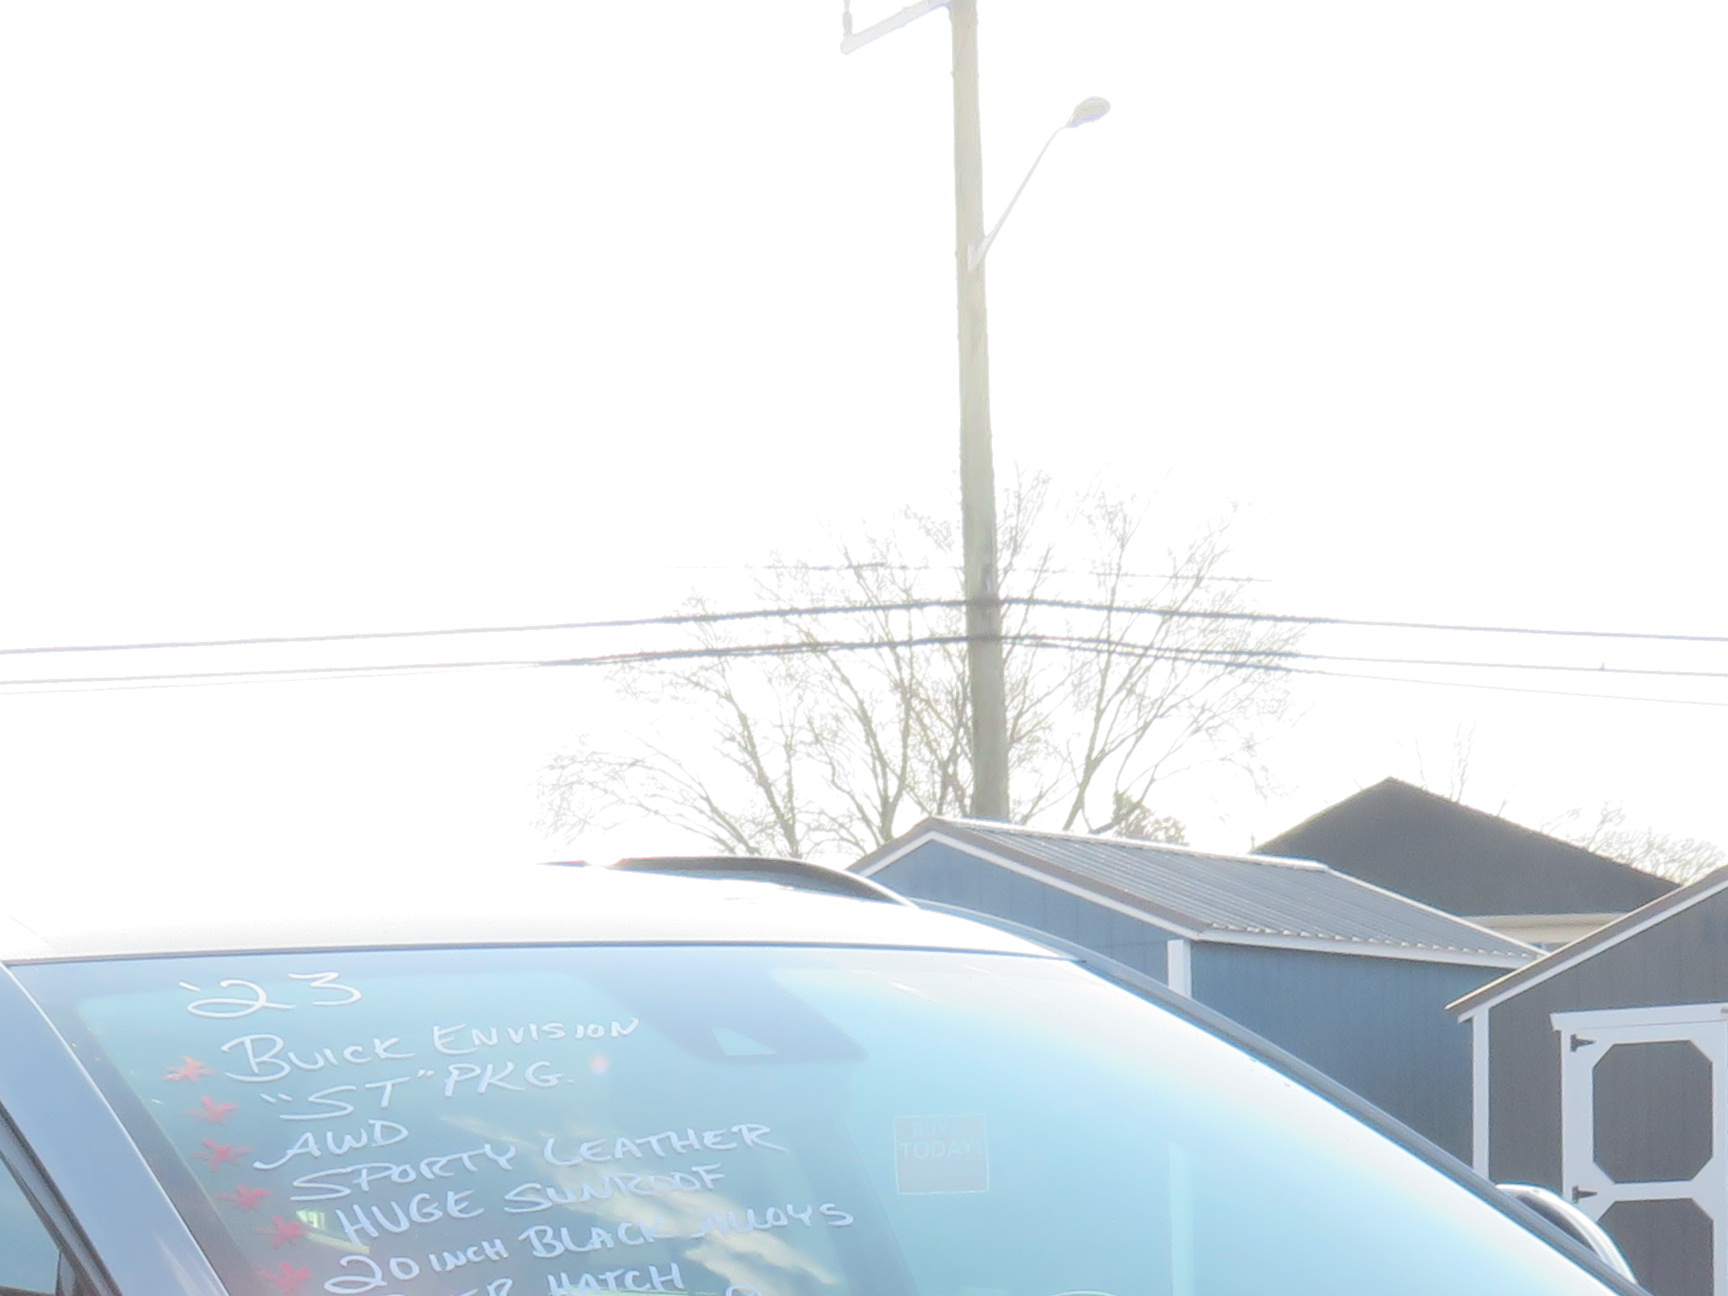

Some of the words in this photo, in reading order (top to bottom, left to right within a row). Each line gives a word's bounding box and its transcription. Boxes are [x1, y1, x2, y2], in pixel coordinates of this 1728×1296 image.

[432, 1017, 640, 1055] ENVISION
[252, 1119, 409, 1170] AWD
[290, 1143, 517, 1201] SPORTY
[543, 1123, 790, 1167] LEATHER
[335, 1190, 484, 1246] HUGE
[503, 1163, 726, 1213] SUNROOF
[323, 1255, 420, 1294] 20
[430, 1238, 510, 1273] INCH
[518, 1212, 675, 1259] BLACK
[689, 1202, 855, 1239] ALLOYS
